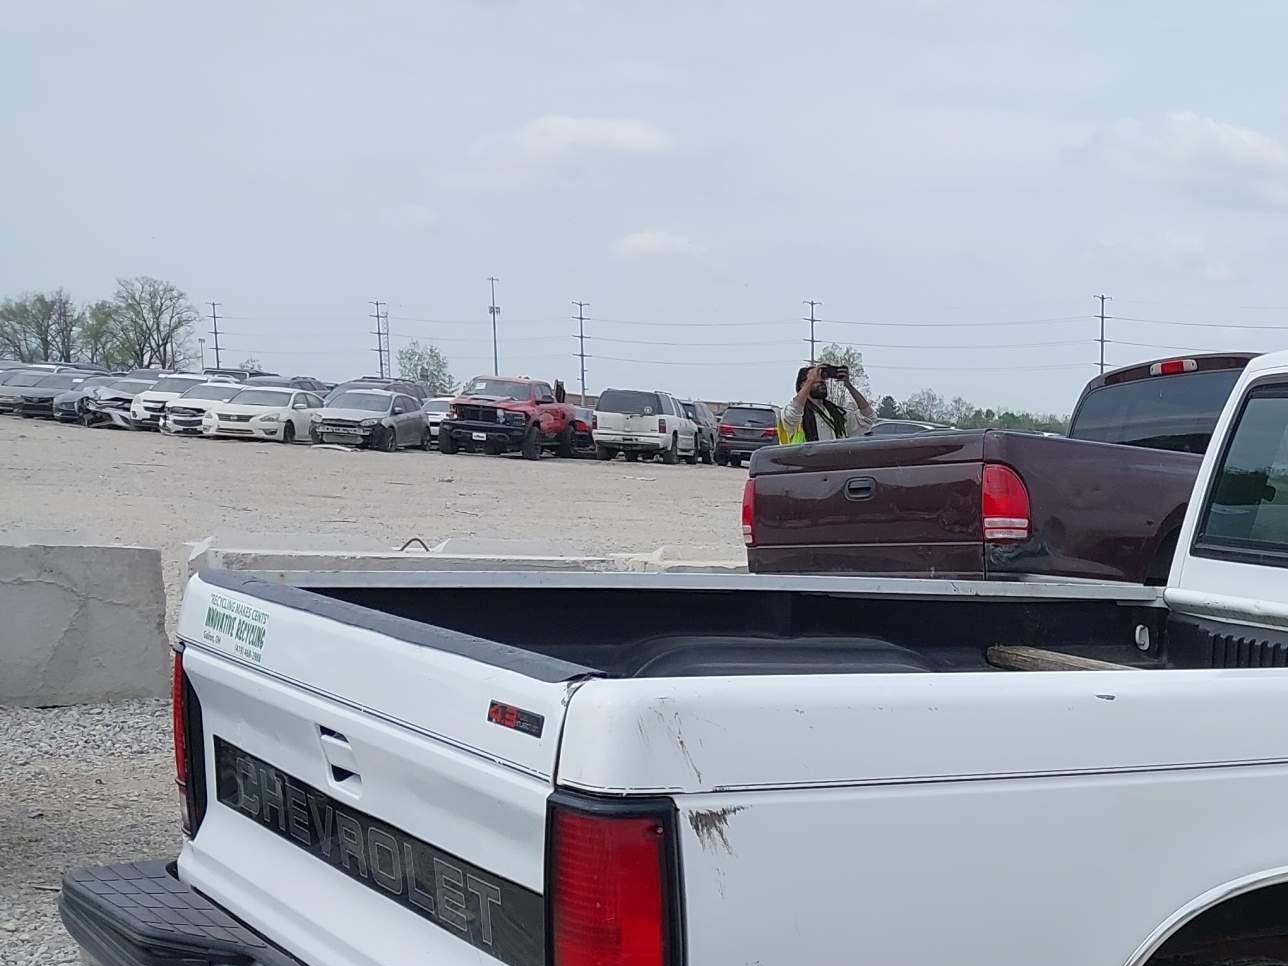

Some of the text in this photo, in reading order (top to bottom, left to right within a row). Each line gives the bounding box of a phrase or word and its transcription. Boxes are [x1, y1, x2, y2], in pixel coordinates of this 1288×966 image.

[205, 607, 266, 650] INNOVATIVE RECYCLING
[235, 603, 253, 619] MAKES
[236, 757, 501, 945] CHEVROLET
